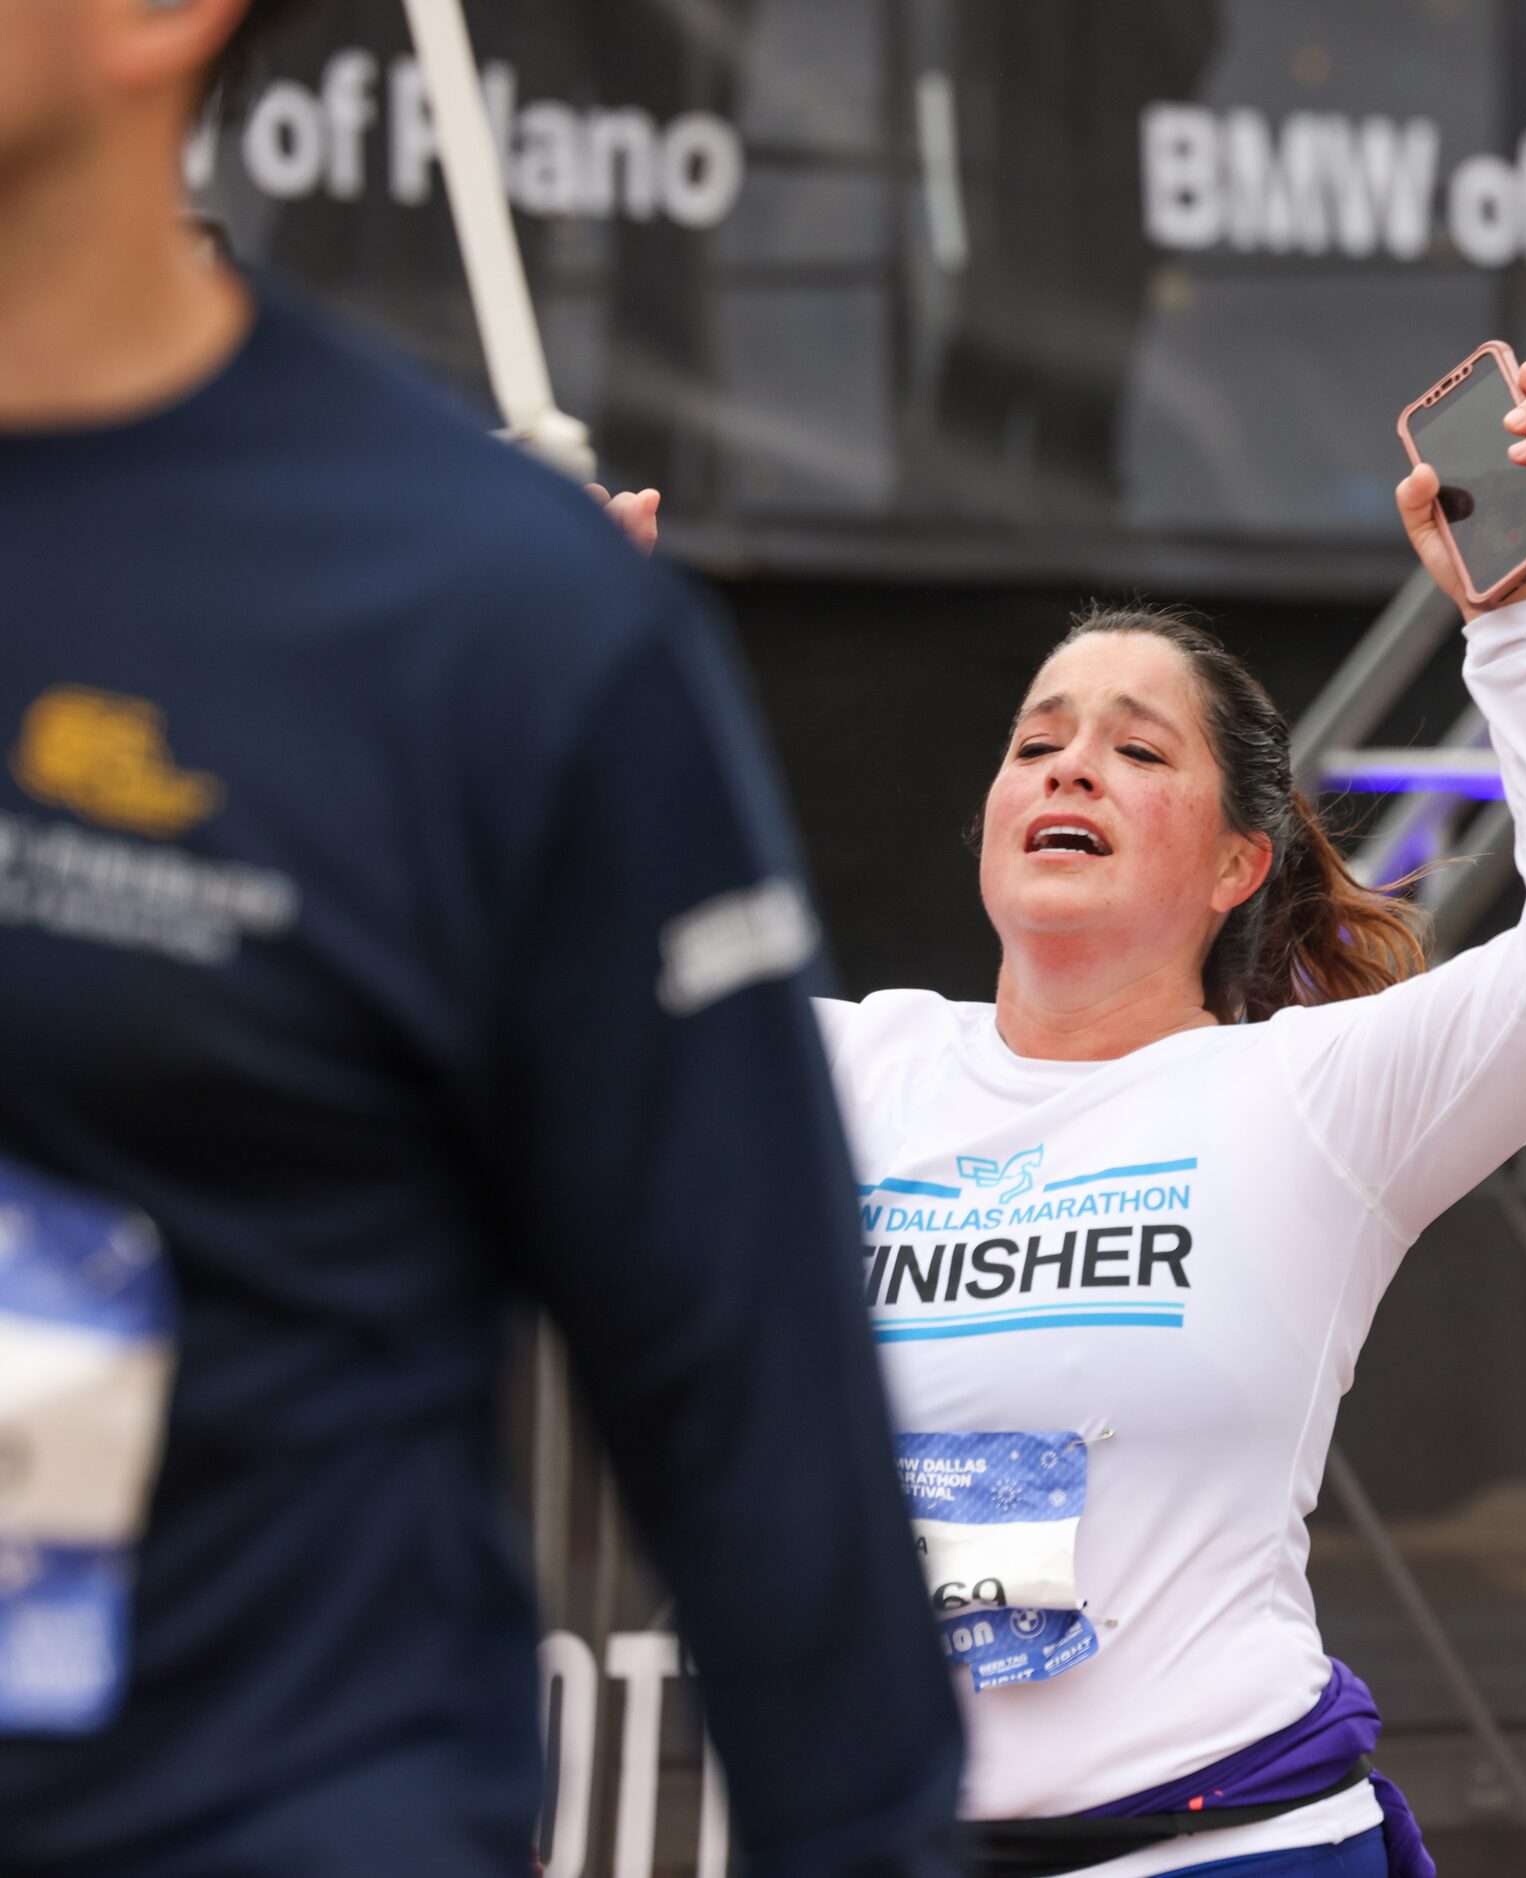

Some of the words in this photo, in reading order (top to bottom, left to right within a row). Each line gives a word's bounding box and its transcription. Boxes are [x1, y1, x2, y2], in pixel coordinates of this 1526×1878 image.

[243, 48, 377, 201] of
[1141, 101, 1438, 262] BMW
[886, 1205, 1004, 1232] DALLAS
[1008, 1185, 1191, 1227] MARATHON
[862, 1224, 1193, 1307] INISHER
[898, 1471, 971, 1487] RATHON
[924, 1458, 987, 1473] DALLAS
